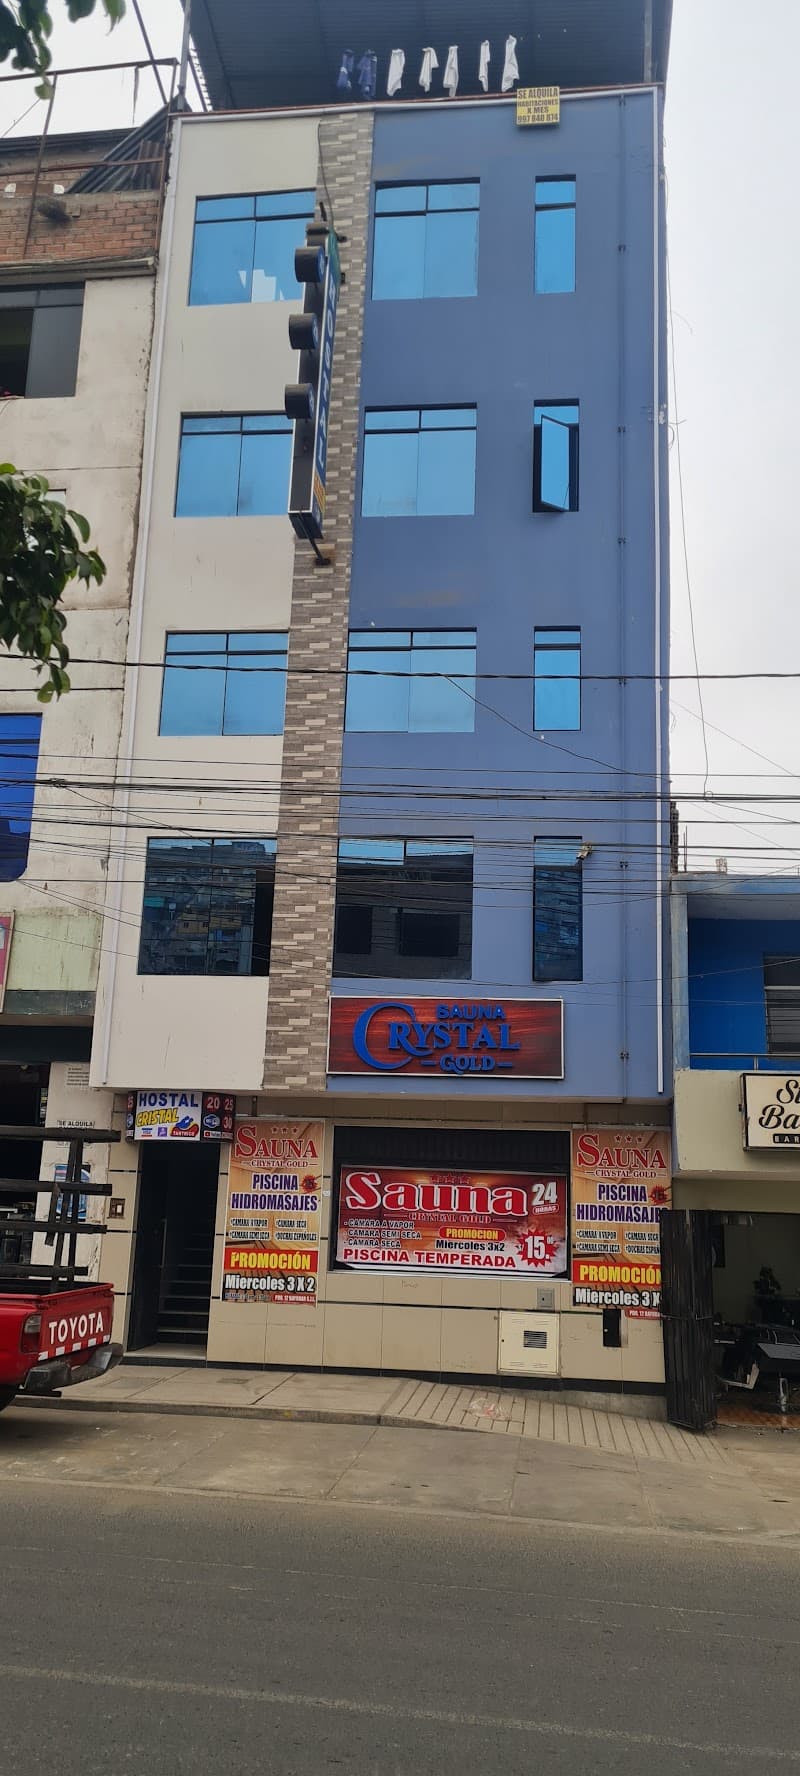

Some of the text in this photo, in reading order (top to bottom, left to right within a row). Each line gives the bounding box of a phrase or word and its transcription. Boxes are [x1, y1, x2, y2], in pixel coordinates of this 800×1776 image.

[518, 88, 558, 99] SE ALQUILA
[318, 274, 336, 468] HOSTAL
[436, 1004, 506, 1020] SAUNA
[353, 1002, 521, 1070] CRYSTAL
[439, 1055, 495, 1075] GOLD
[139, 1092, 199, 1107] HOSTAL
[206, 1097, 220, 1109] 20
[224, 1098, 234, 1111] 25
[136, 1107, 179, 1127] CRISTAL
[223, 1117, 233, 1129] 30
[235, 1126, 318, 1158] SAUNA
[577, 1134, 667, 1169] SAUNA
[252, 1174, 298, 1190] PISCINA
[596, 1170, 630, 1178] CRYSTAL
[231, 1193, 318, 1211] HIDROMASAJES
[346, 1172, 528, 1216] Sauna
[531, 1182, 558, 1206] 24
[598, 1184, 647, 1202] PISCINA
[382, 1230, 400, 1238] SEMI
[401, 1231, 421, 1239] SECA
[446, 1228, 498, 1240] PROMOCION
[382, 1240, 400, 1248] SECA
[436, 1240, 505, 1252] Miercoles 3x2
[230, 1252, 310, 1270] PROMOCIÓN
[344, 1248, 516, 1268] PISCINA TEMPERADA
[225, 1274, 285, 1290] Miercoles
[287, 1276, 295, 1291] 3
[306, 1277, 315, 1292] 2
[576, 1288, 639, 1305] Miercoles
[641, 1291, 650, 1306] 3
[48, 1312, 104, 1344] TOYOTA
